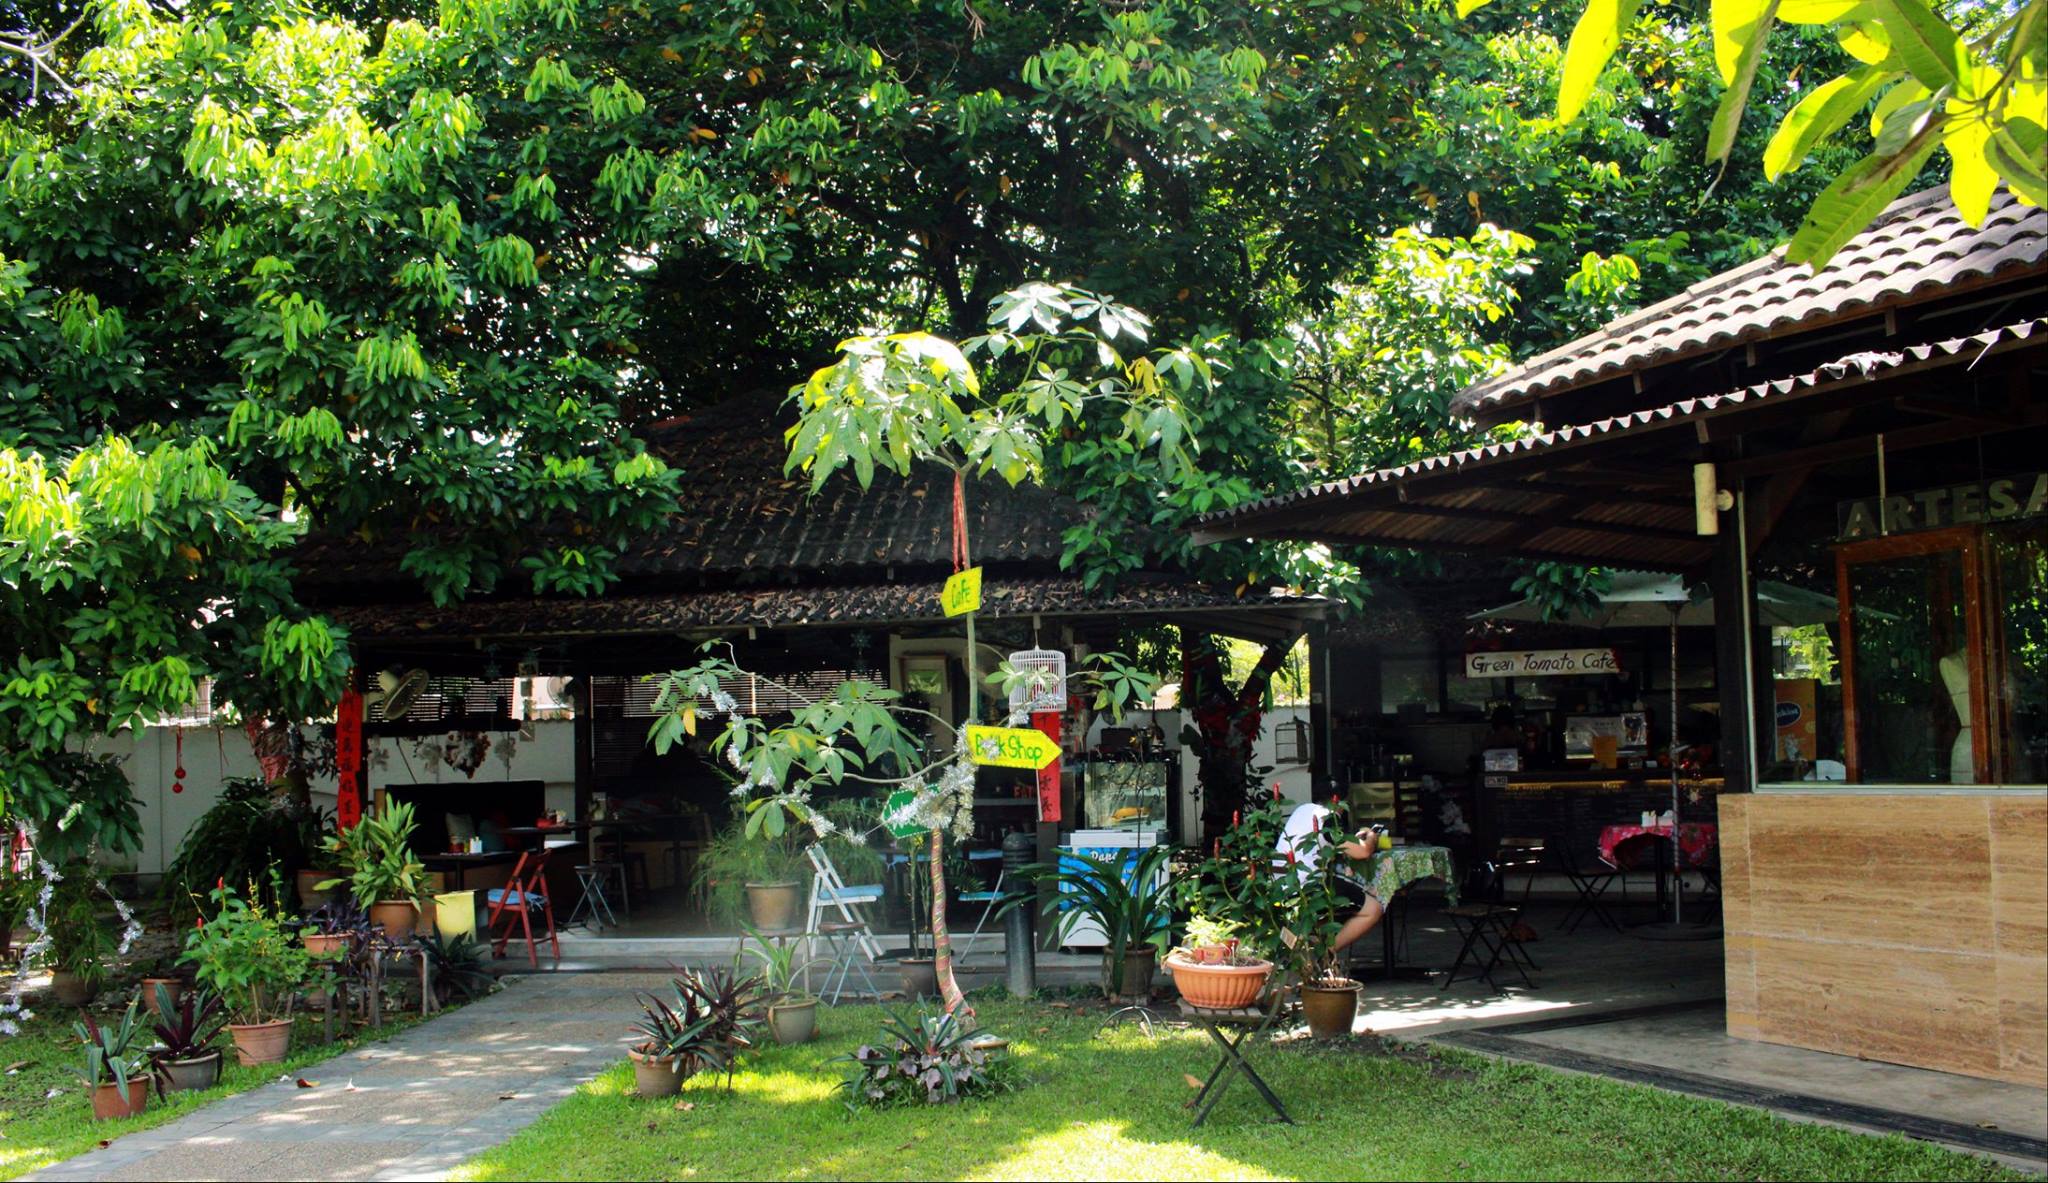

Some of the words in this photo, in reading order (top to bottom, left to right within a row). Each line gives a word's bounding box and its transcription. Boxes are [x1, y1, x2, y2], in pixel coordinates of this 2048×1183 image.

[1845, 472, 2048, 539] ARTESA
[1471, 656, 1514, 673] Green
[1523, 652, 1575, 671] Tomato
[1007, 735, 1043, 767] Shop
